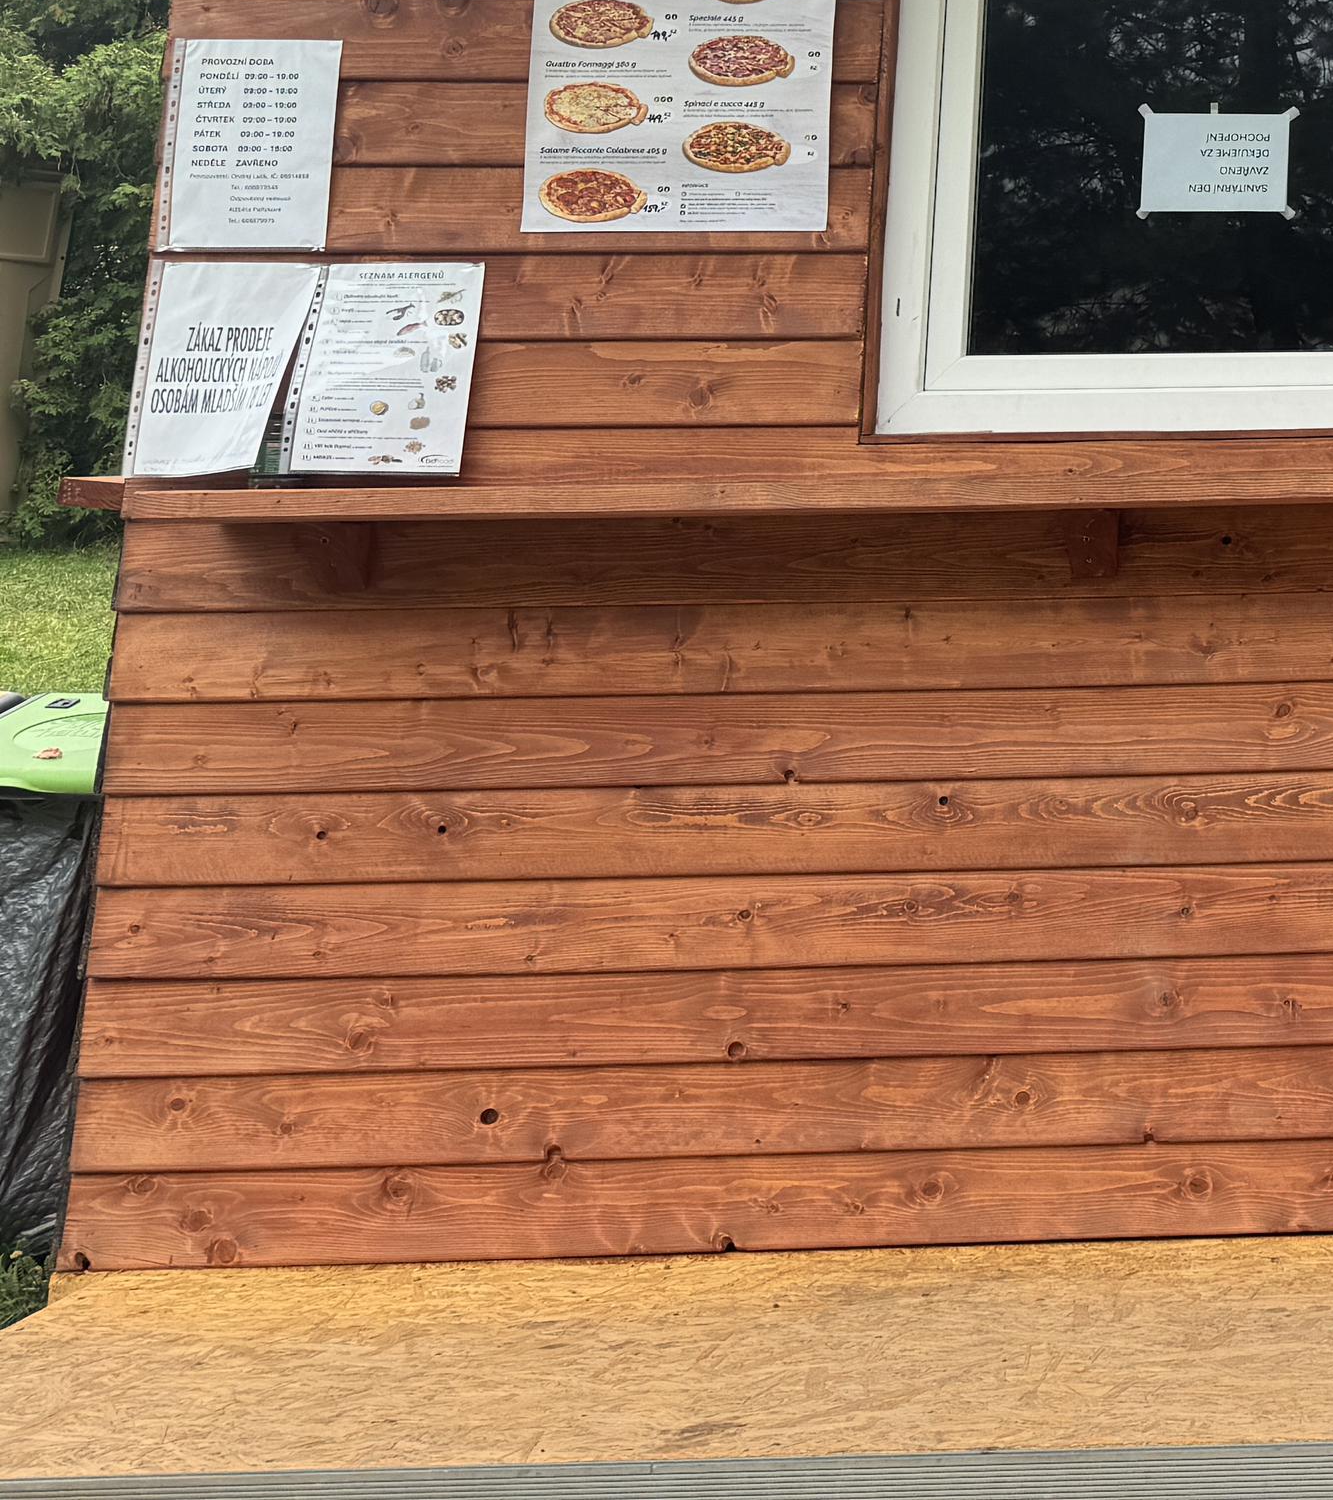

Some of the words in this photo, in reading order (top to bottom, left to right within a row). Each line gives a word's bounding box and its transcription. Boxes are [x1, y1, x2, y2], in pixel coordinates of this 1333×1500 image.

[201, 58, 247, 66] PROVOZNÍ
[249, 58, 274, 66] DOBA
[199, 72, 239, 80] PONDĚLÍ
[198, 86, 227, 94] ÚTERÝ
[196, 100, 231, 108] STŘEDA
[195, 115, 235, 123] ČTVRTEK
[193, 129, 221, 138] PÁTEK
[1206, 133, 1271, 144] POCHOPENÍ
[540, 146, 570, 154] Salame
[571, 146, 605, 154] Piccante
[1200, 149, 1213, 158] ZA
[1216, 149, 1269, 159] DĚKUJEME
[191, 158, 226, 167] NEDĚLE
[235, 158, 278, 167] ZAVŘENO
[1220, 166, 1269, 177] ZAVŘENO
[1188, 184, 1211, 193] DEN
[1213, 184, 1268, 194] SANITÁRNÍ
[360, 272, 394, 280] SEZNAM
[397, 270, 445, 280] ALERGENŮ
[186, 322, 224, 351] ZÁKAZ
[225, 327, 274, 352] PRODEJE
[155, 353, 248, 383] ALKOHOLICKÝCH
[150, 383, 199, 414] OSOBÁM
